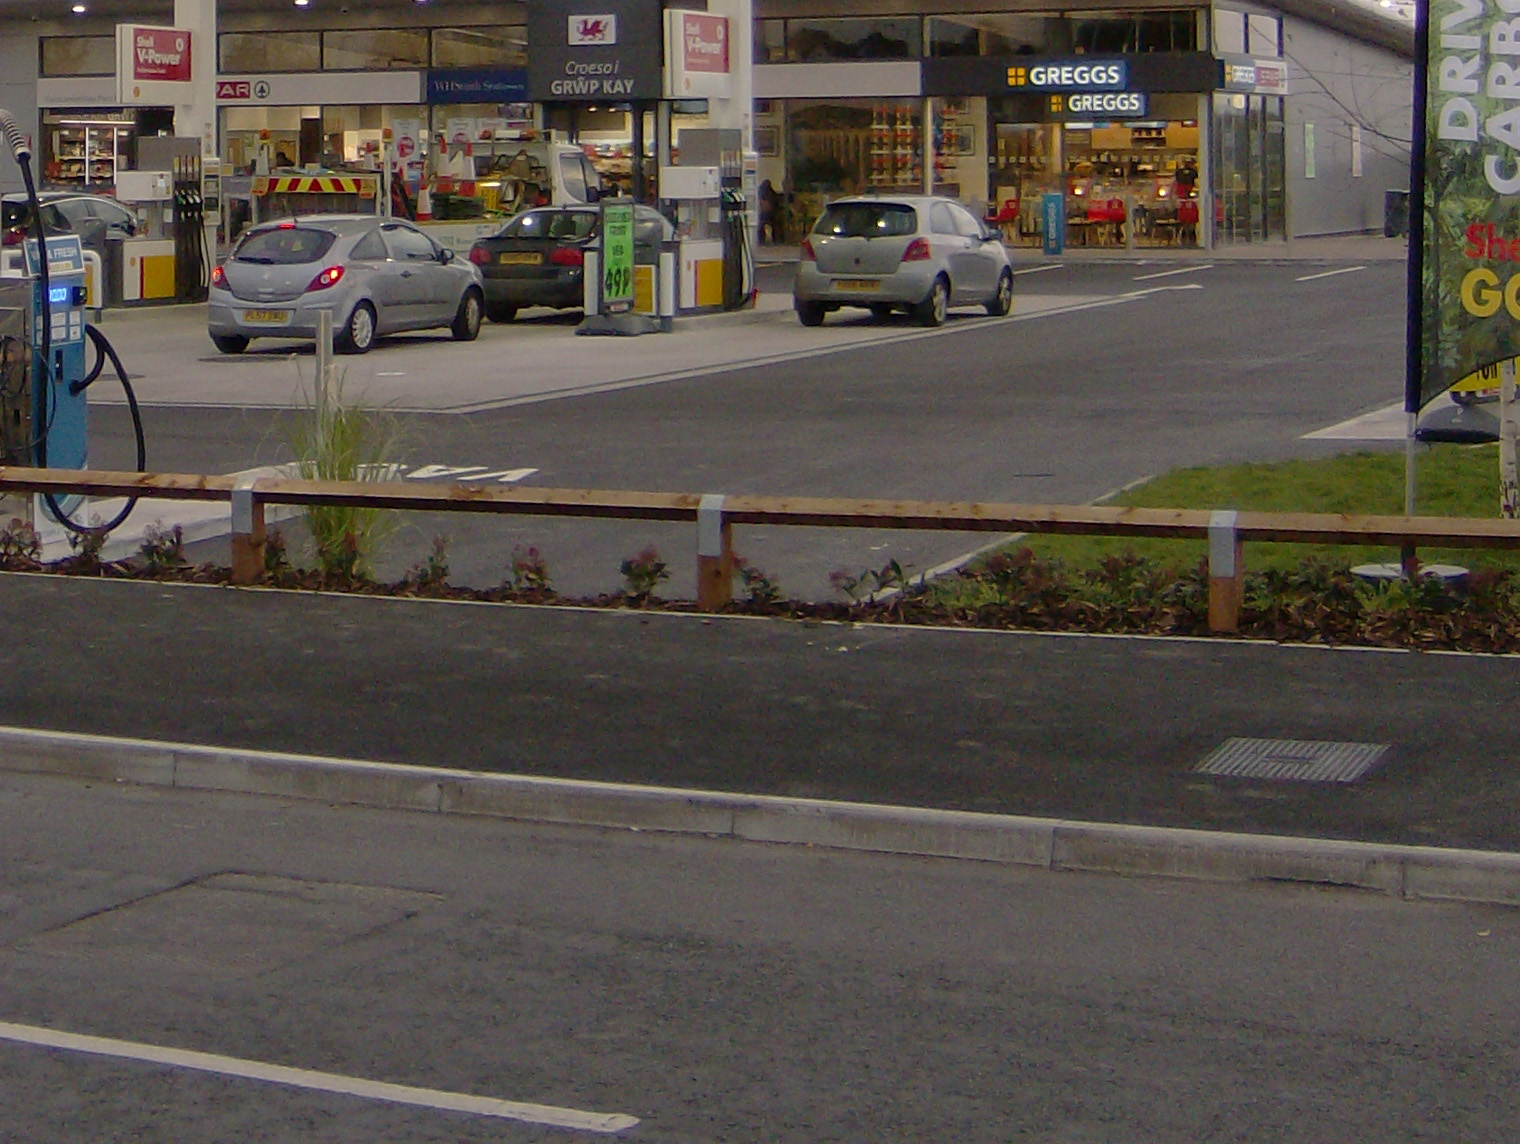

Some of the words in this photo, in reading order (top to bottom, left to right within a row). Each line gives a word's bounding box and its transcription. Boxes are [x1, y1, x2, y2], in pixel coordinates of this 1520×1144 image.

[136, 48, 181, 66] V-Power
[565, 61, 611, 75] Croeso
[1029, 66, 1119, 85] GREGGS
[216, 83, 250, 98] AR
[551, 75, 598, 95] GRŴP
[602, 79, 635, 94] KAY
[1068, 93, 1140, 112] GREGGS
